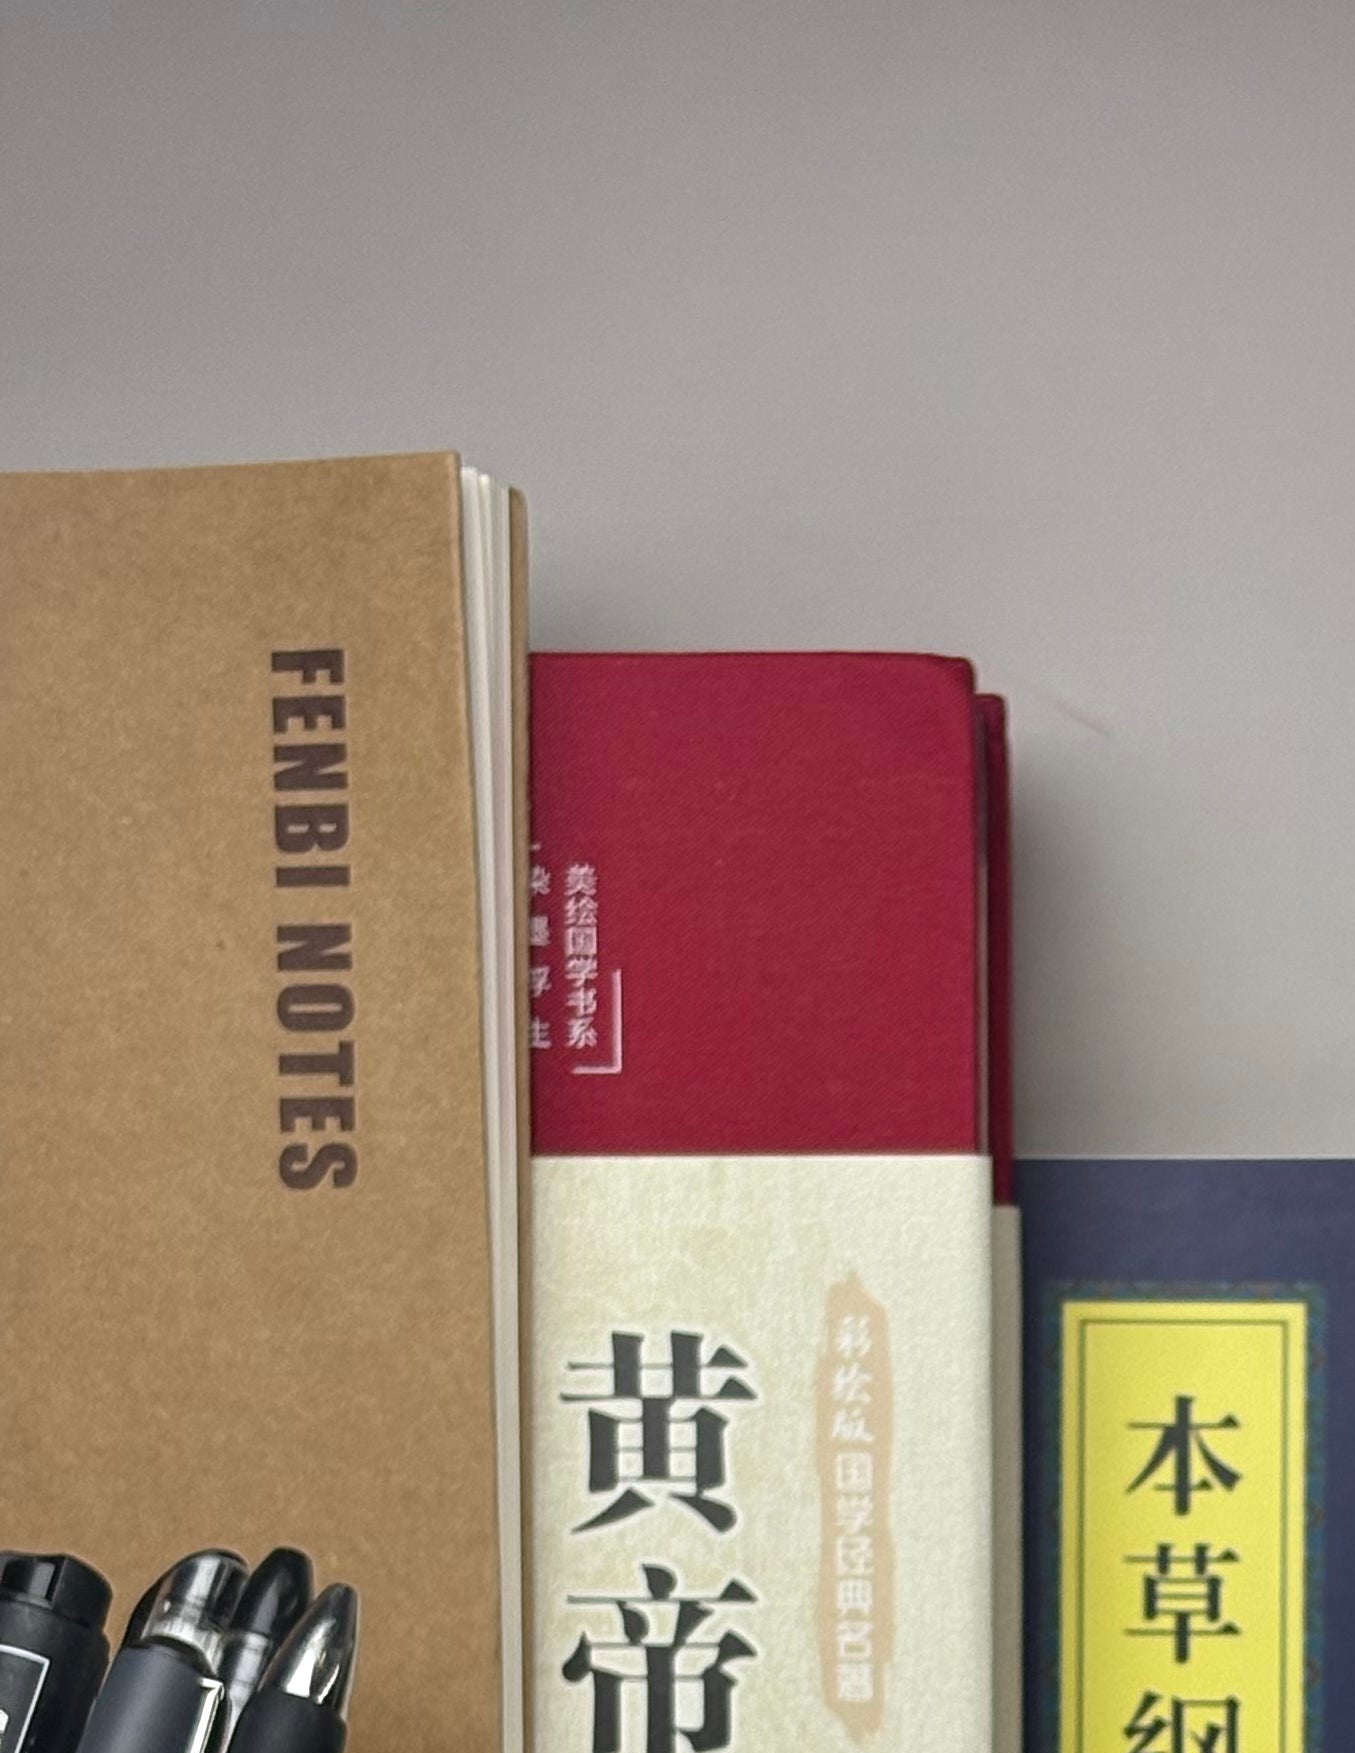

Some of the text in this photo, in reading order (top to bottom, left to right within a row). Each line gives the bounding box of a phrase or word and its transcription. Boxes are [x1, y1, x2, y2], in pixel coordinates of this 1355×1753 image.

[271, 648, 358, 1191] FENBI NOTES
[563, 862, 599, 1049] 美绘国学书系
